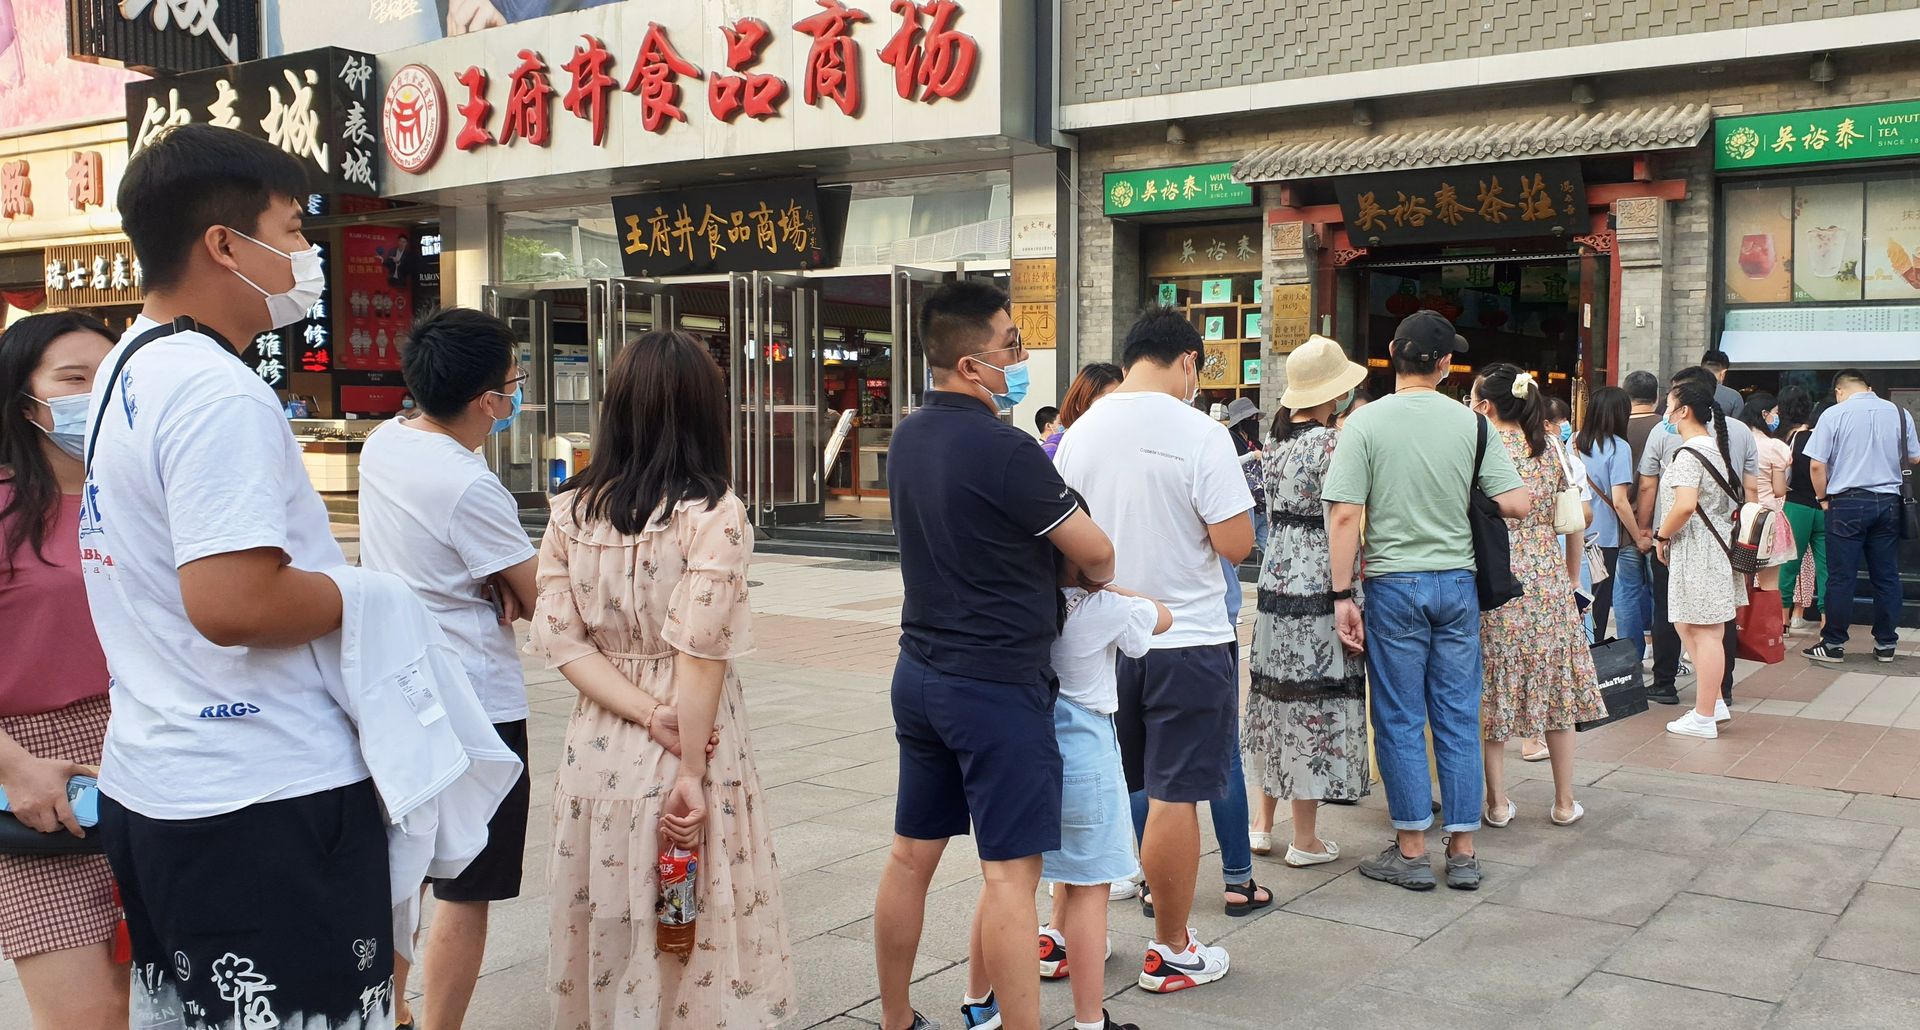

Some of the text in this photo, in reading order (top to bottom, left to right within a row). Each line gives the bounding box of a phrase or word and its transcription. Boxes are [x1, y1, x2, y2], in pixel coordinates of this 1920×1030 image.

[455, 0, 978, 151] 王府井食品商场
[338, 54, 376, 192] 钟表城
[1878, 127, 1898, 137] TEA
[1878, 139, 1904, 147] SINCE
[1209, 173, 1232, 182] WUYU
[1209, 183, 1224, 191] TEA
[255, 332, 286, 386] 维修
